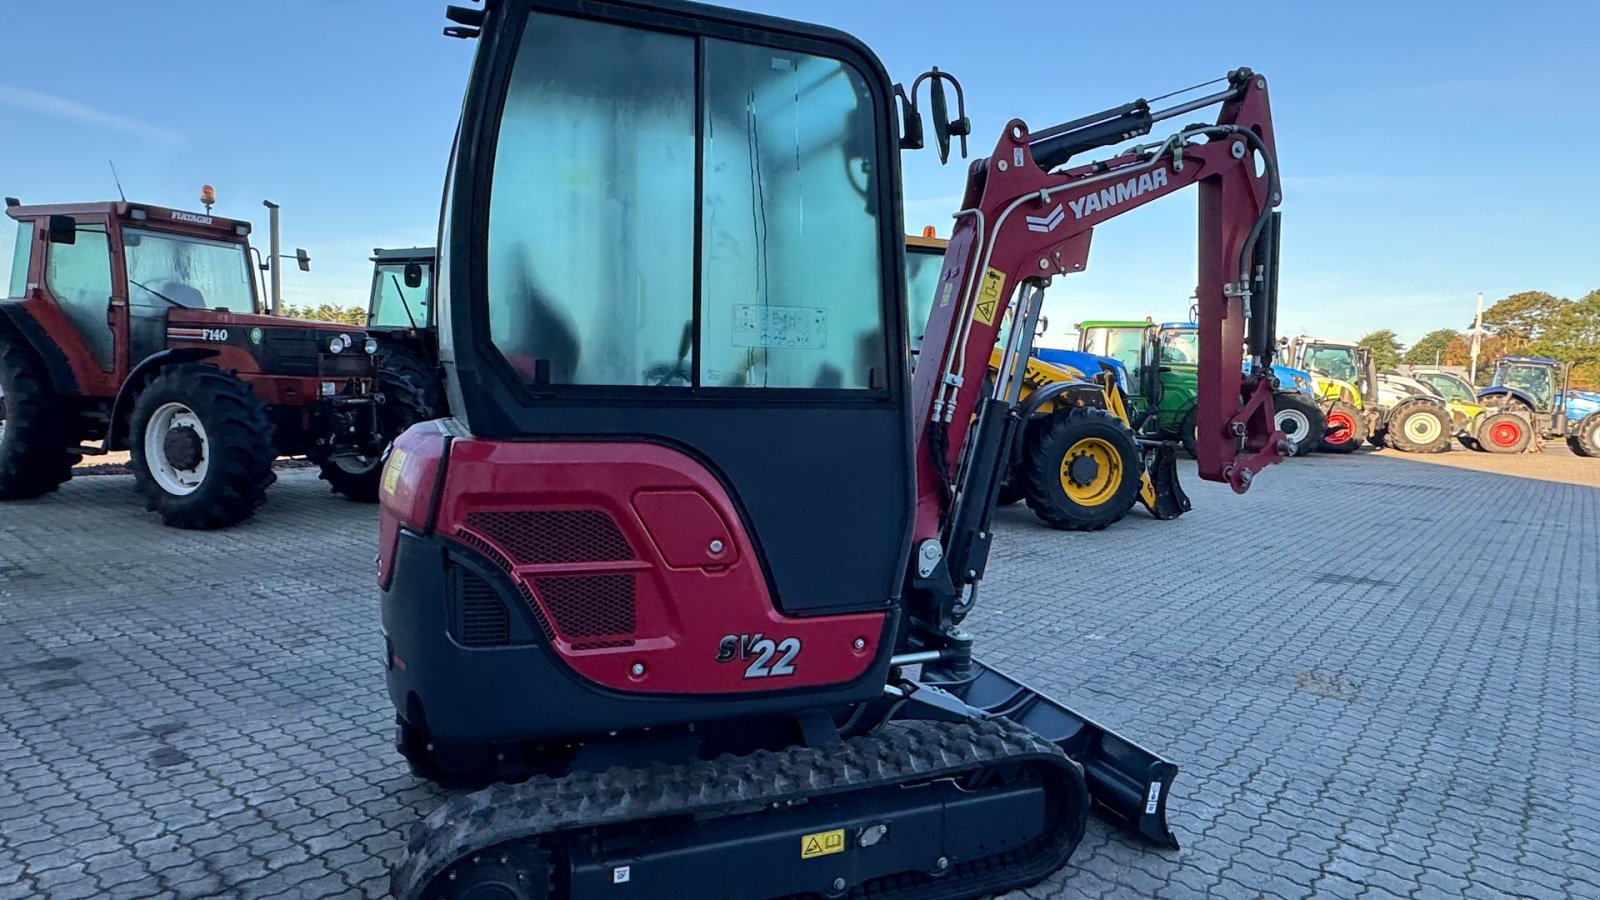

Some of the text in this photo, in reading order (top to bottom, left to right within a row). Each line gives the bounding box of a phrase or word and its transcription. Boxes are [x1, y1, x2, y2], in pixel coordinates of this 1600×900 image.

[1068, 167, 1168, 219] YANMAR
[171, 211, 213, 225] FIATAGRI
[202, 328, 228, 341] F140
